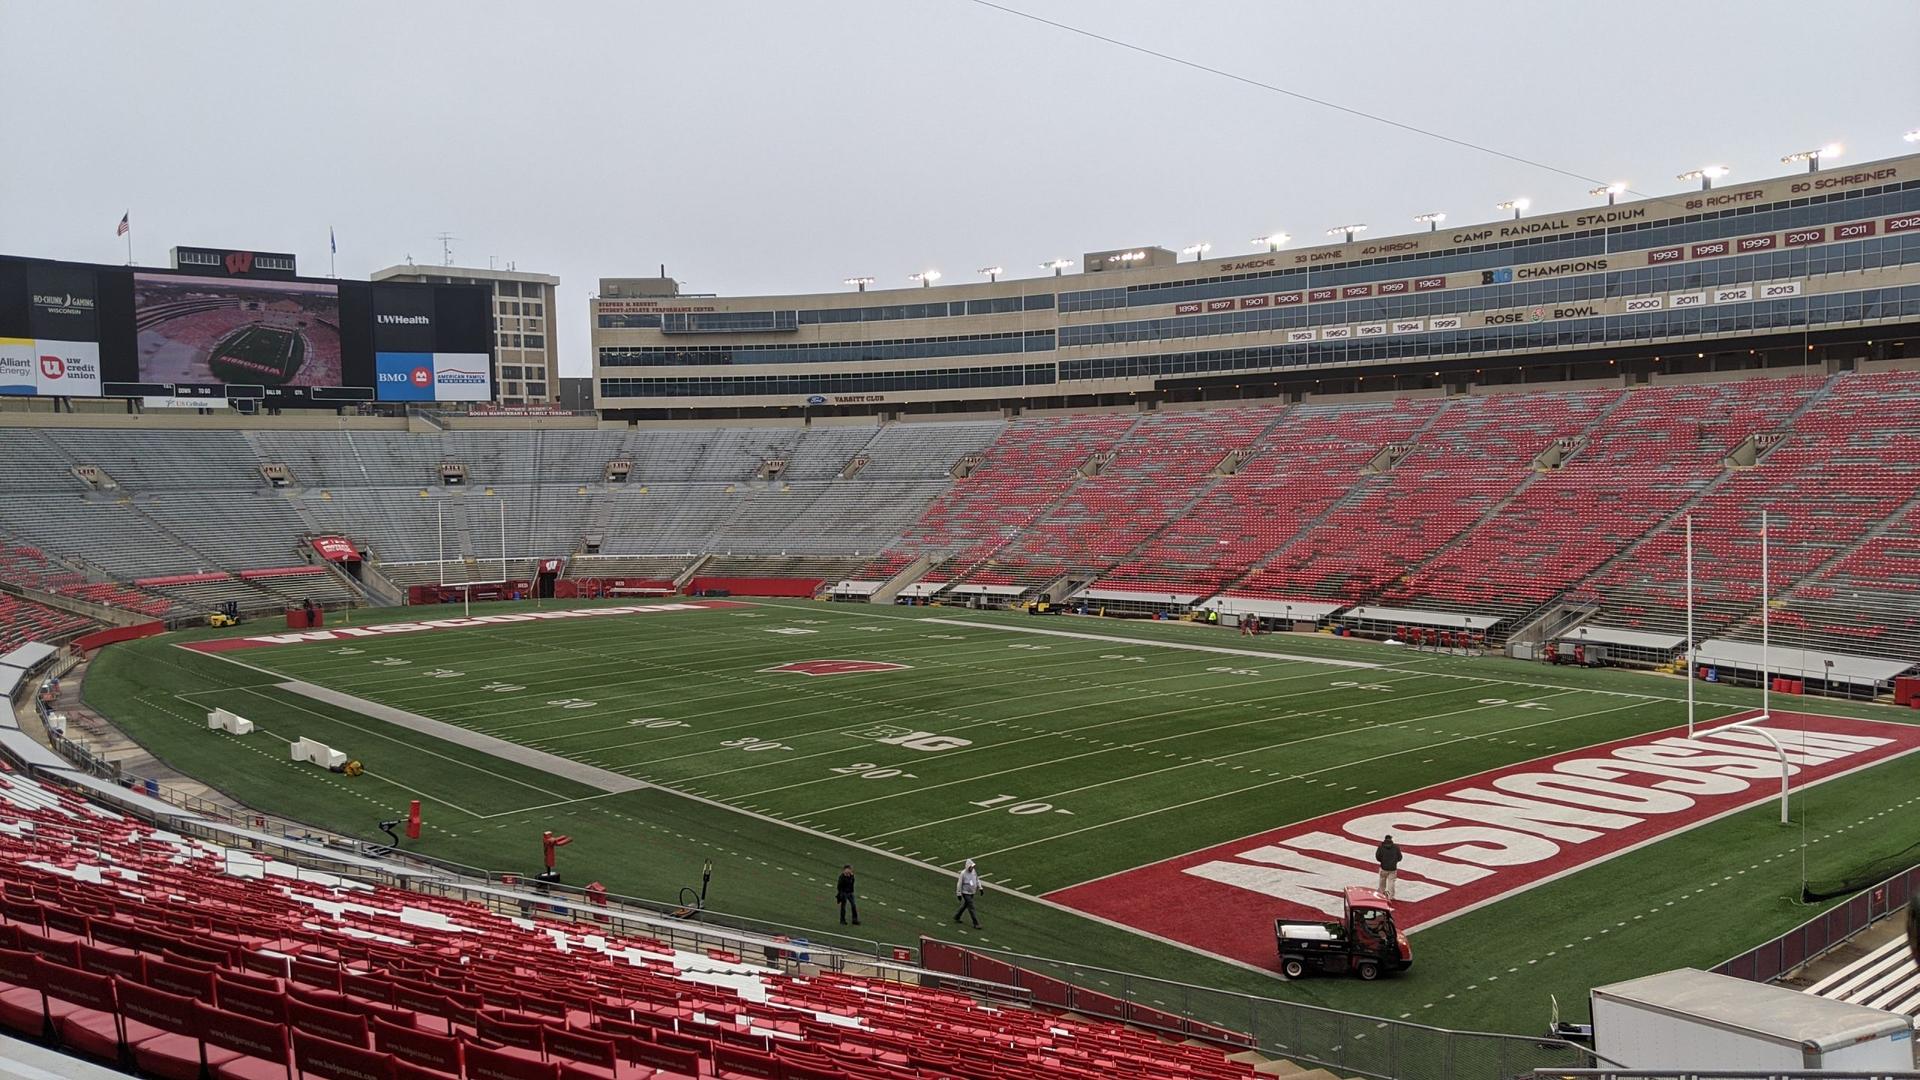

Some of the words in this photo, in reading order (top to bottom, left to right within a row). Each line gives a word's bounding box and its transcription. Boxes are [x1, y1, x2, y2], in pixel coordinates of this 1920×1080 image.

[1791, 183, 1811, 193] 80
[1815, 168, 1896, 190] SCHREINER
[1685, 200, 1703, 210] 88
[1706, 190, 1763, 207] RICHTER
[1453, 230, 1492, 244] CAMP
[1500, 219, 1569, 237] RANDALL
[1577, 208, 1645, 226] STADIUM
[1890, 217, 1920, 229] 2012
[1840, 225, 1867, 236] 2011
[1789, 231, 1820, 244] 2010
[1362, 246, 1376, 255] 40
[1379, 241, 1419, 252] HIRSCH
[1742, 238, 1771, 249] 1999
[1696, 244, 1724, 255] 1998
[1295, 255, 1307, 263] 33
[1310, 250, 1343, 261] DAYNE
[1653, 250, 1679, 261] 1993
[225, 252, 253, 274] W
[1220, 263, 1233, 272] 35
[1235, 259, 1276, 271] AMECHE
[1517, 259, 1608, 279] CHAMPIONS
[1382, 283, 1404, 292] 1959
[1418, 279, 1441, 288] 1962
[1313, 291, 1332, 299] 1912
[1346, 287, 1368, 296] 1952
[1719, 290, 1747, 301] 2012
[1766, 285, 1794, 296] 2013
[72, 297, 94, 307] GAMING
[1245, 298, 1264, 306] 1901
[1278, 294, 1299, 303] 1906
[1676, 295, 1699, 305] 2011
[1179, 304, 1199, 313] 1896
[1211, 301, 1231, 309] 1897
[1628, 300, 1660, 311] 2000
[48, 307, 82, 315] WISCONSIN
[1485, 312, 1523, 325] ROSE
[1554, 306, 1598, 319] BOWL
[1397, 322, 1419, 331] 1994
[1434, 319, 1457, 328] 1999
[1325, 329, 1347, 337] 1960
[1360, 326, 1382, 335] 1963
[0, 357, 31, 368] Alliant
[66, 363, 95, 372] credit
[66, 371, 96, 380] union
[379, 373, 407, 382] BMO
[243, 603, 708, 644] WISCONSIN
[626, 717, 683, 728] 40
[719, 737, 782, 752] 30
[829, 762, 903, 780] 20
[969, 794, 1054, 816] 10
[1181, 727, 1898, 918] WISCONSIN
